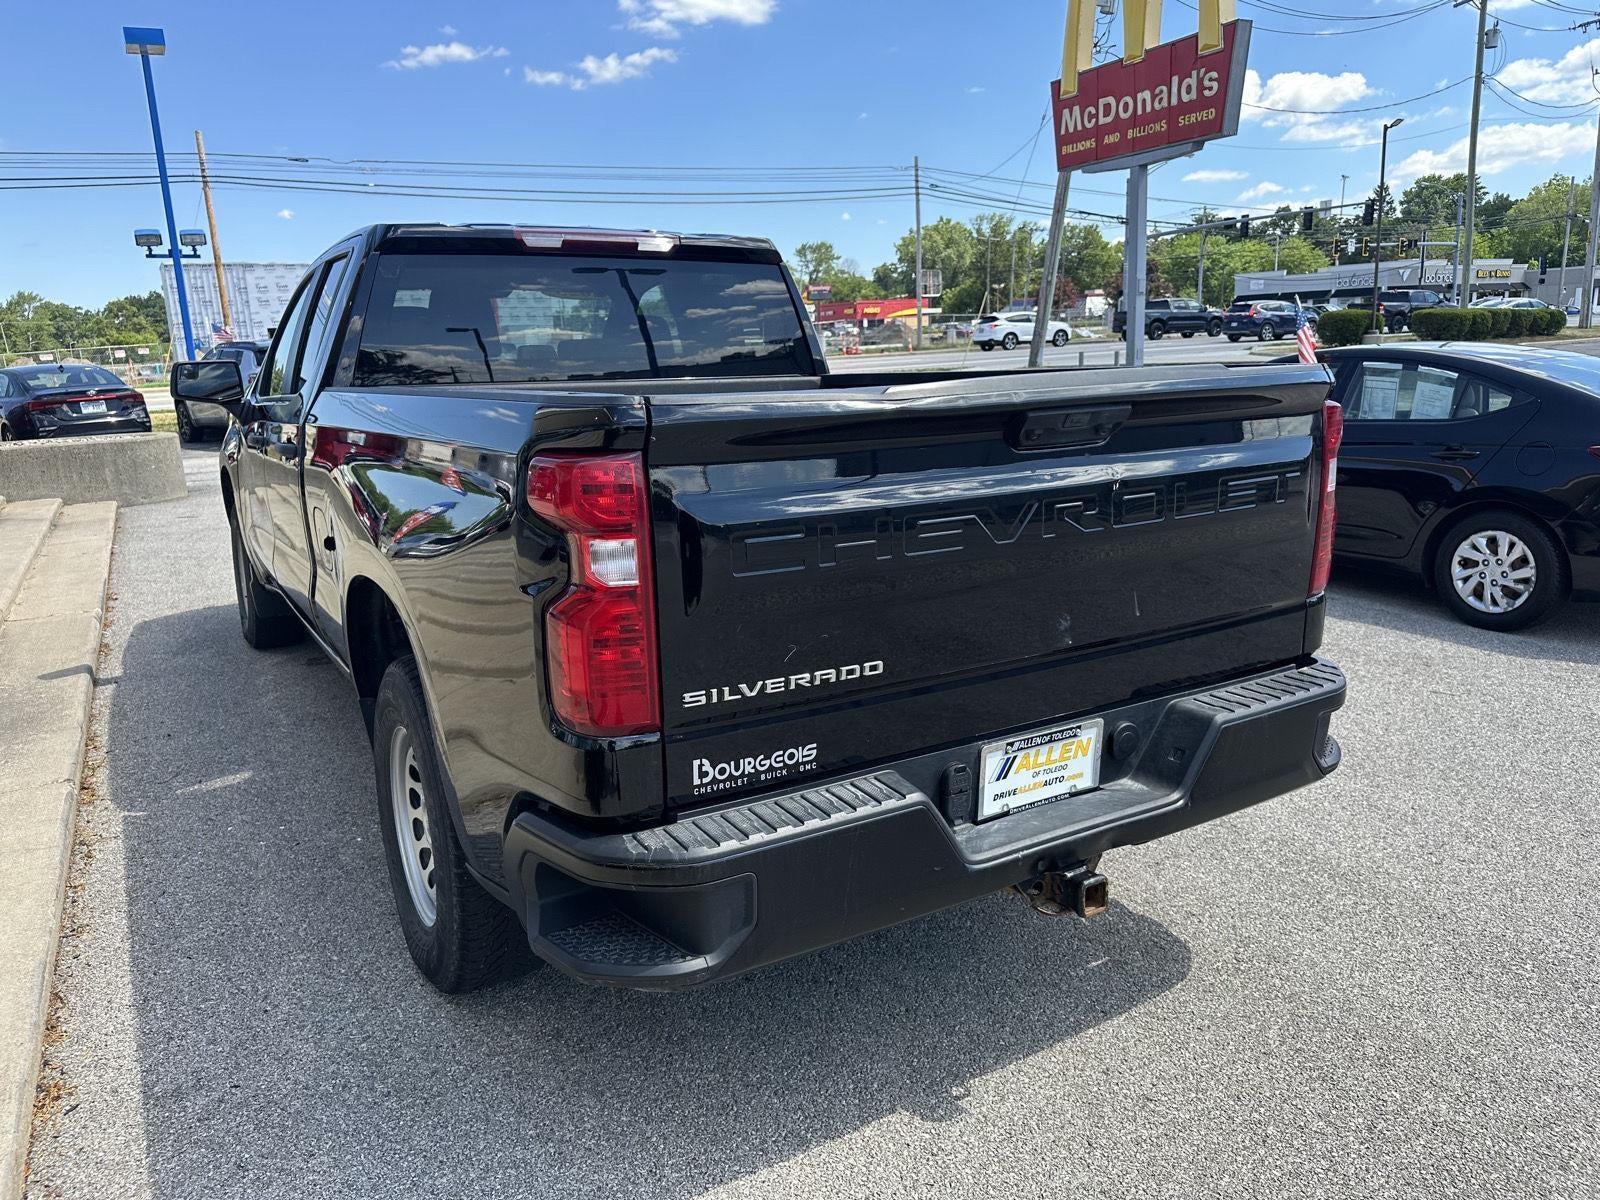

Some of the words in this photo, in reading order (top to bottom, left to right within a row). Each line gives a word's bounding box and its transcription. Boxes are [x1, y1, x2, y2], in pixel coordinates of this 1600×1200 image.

[1060, 67, 1219, 135] McDonald's
[1061, 137, 1096, 155] BILLIONS
[1103, 132, 1120, 145] AND
[1127, 120, 1168, 140] BILLIONS
[1178, 107, 1216, 127] SERVED
[731, 470, 1301, 577] CHEVROLET
[682, 660, 884, 708] SILVERADO
[1014, 737, 1092, 774] ALLEN
[1018, 736, 1040, 749] ALLEN
[1041, 734, 1051, 743] OF
[1051, 729, 1075, 741] TOLEDO
[693, 777, 748, 795] CHEVROLET
[760, 769, 788, 781] BUICK
[799, 762, 817, 772] GMC
[1032, 770, 1041, 778] OF
[1042, 763, 1068, 775] TOLEDO
